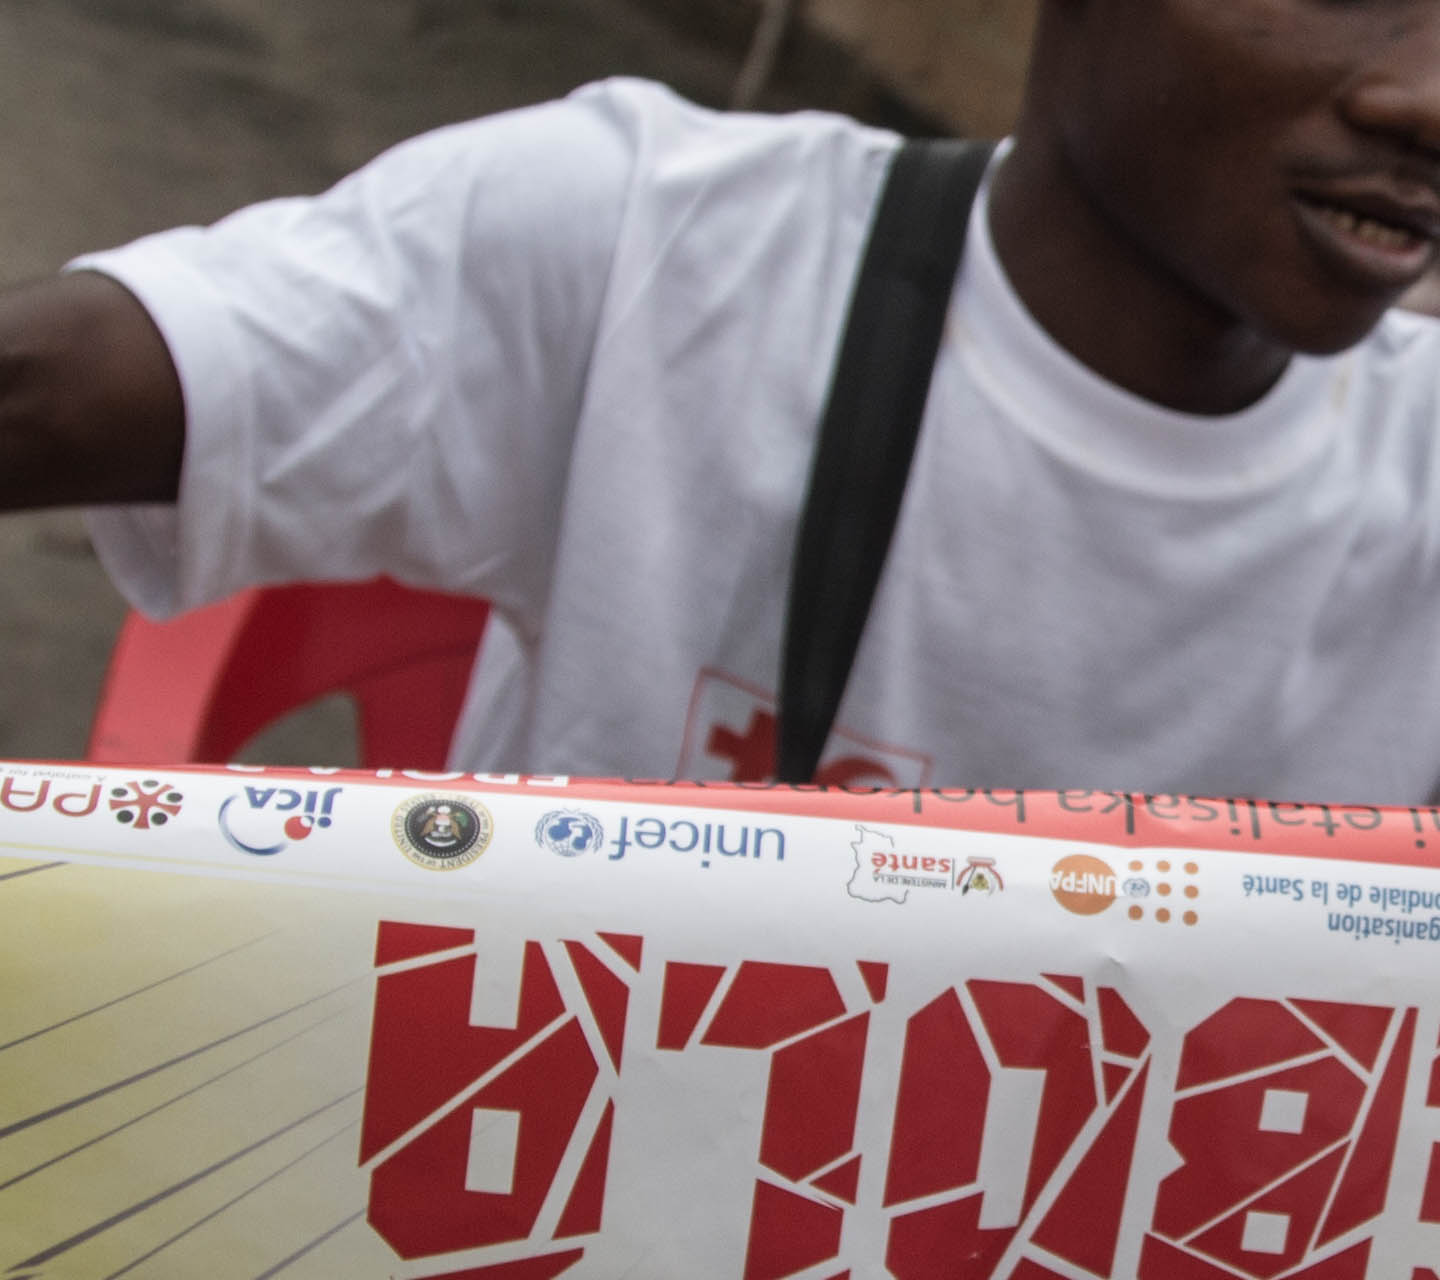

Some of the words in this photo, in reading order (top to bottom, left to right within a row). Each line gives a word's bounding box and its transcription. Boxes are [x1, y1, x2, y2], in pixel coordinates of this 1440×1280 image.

[608, 815, 786, 869] unicef
[871, 852, 951, 875] santé
[1048, 869, 1121, 898] UNFPA
[1242, 873, 1305, 903] Santé
[1310, 879, 1329, 903] la
[1336, 882, 1363, 905] de
